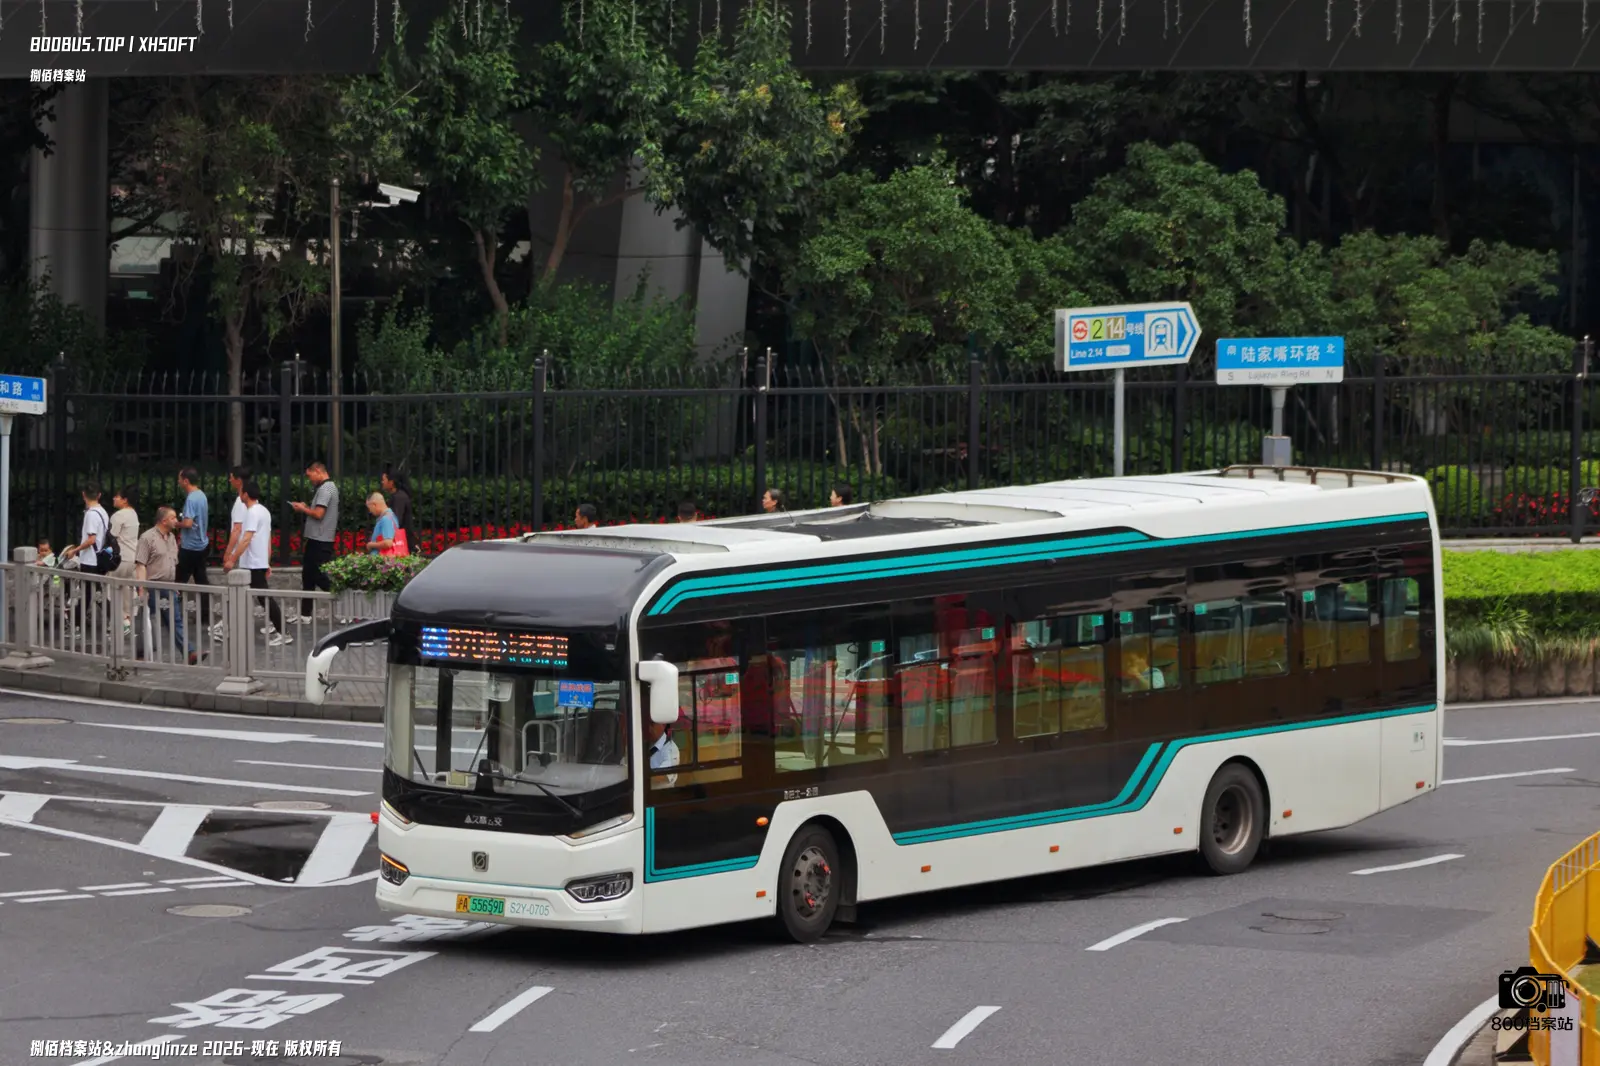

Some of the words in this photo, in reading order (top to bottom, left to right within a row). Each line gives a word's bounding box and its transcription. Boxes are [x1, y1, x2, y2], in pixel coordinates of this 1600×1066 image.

[1092, 319, 1103, 340] 2
[1106, 317, 1125, 339] 14
[1070, 349, 1087, 359] Line
[1240, 344, 1321, 363] 陆家嘴环路
[1325, 343, 1336, 354] 北
[509, 902, 550, 917] S2Y-0705
